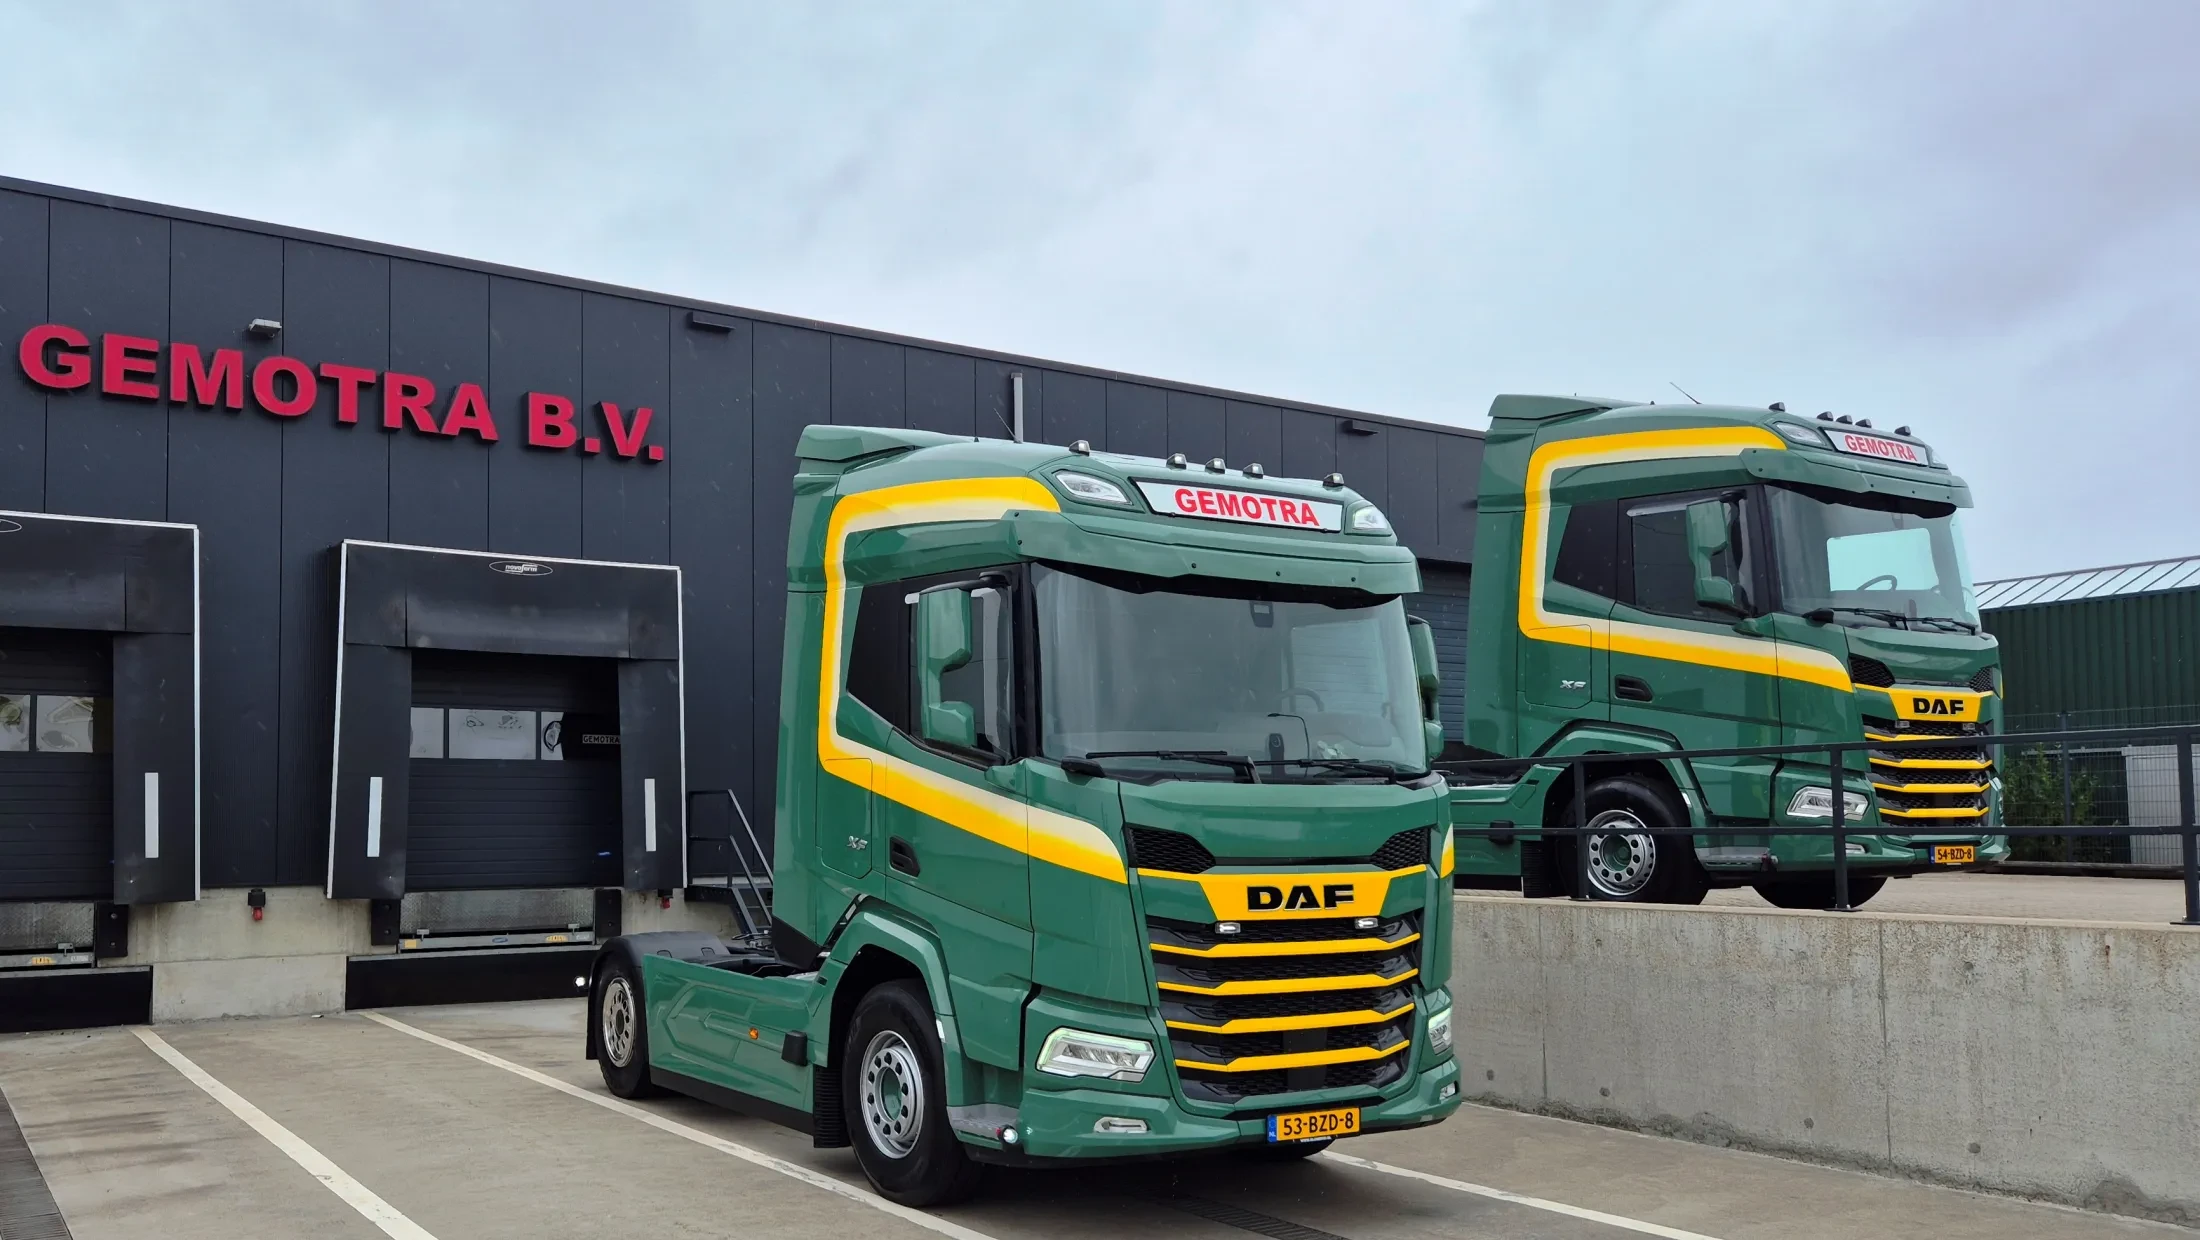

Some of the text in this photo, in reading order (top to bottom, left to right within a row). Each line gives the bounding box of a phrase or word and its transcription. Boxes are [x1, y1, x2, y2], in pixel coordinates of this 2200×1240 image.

[19, 324, 664, 462] GEMOTRA B.V.
[1844, 434, 1918, 461] GEMOTRA
[1174, 488, 1320, 527] GEMOTRA
[1560, 680, 1586, 690] XF
[1913, 697, 1964, 715] DAF
[582, 735, 620, 744] GEMOTRA
[1937, 848, 1972, 860] 54-BZD-8
[1247, 884, 1354, 911] DAF
[1283, 1112, 1354, 1136] 53-BZD-8
